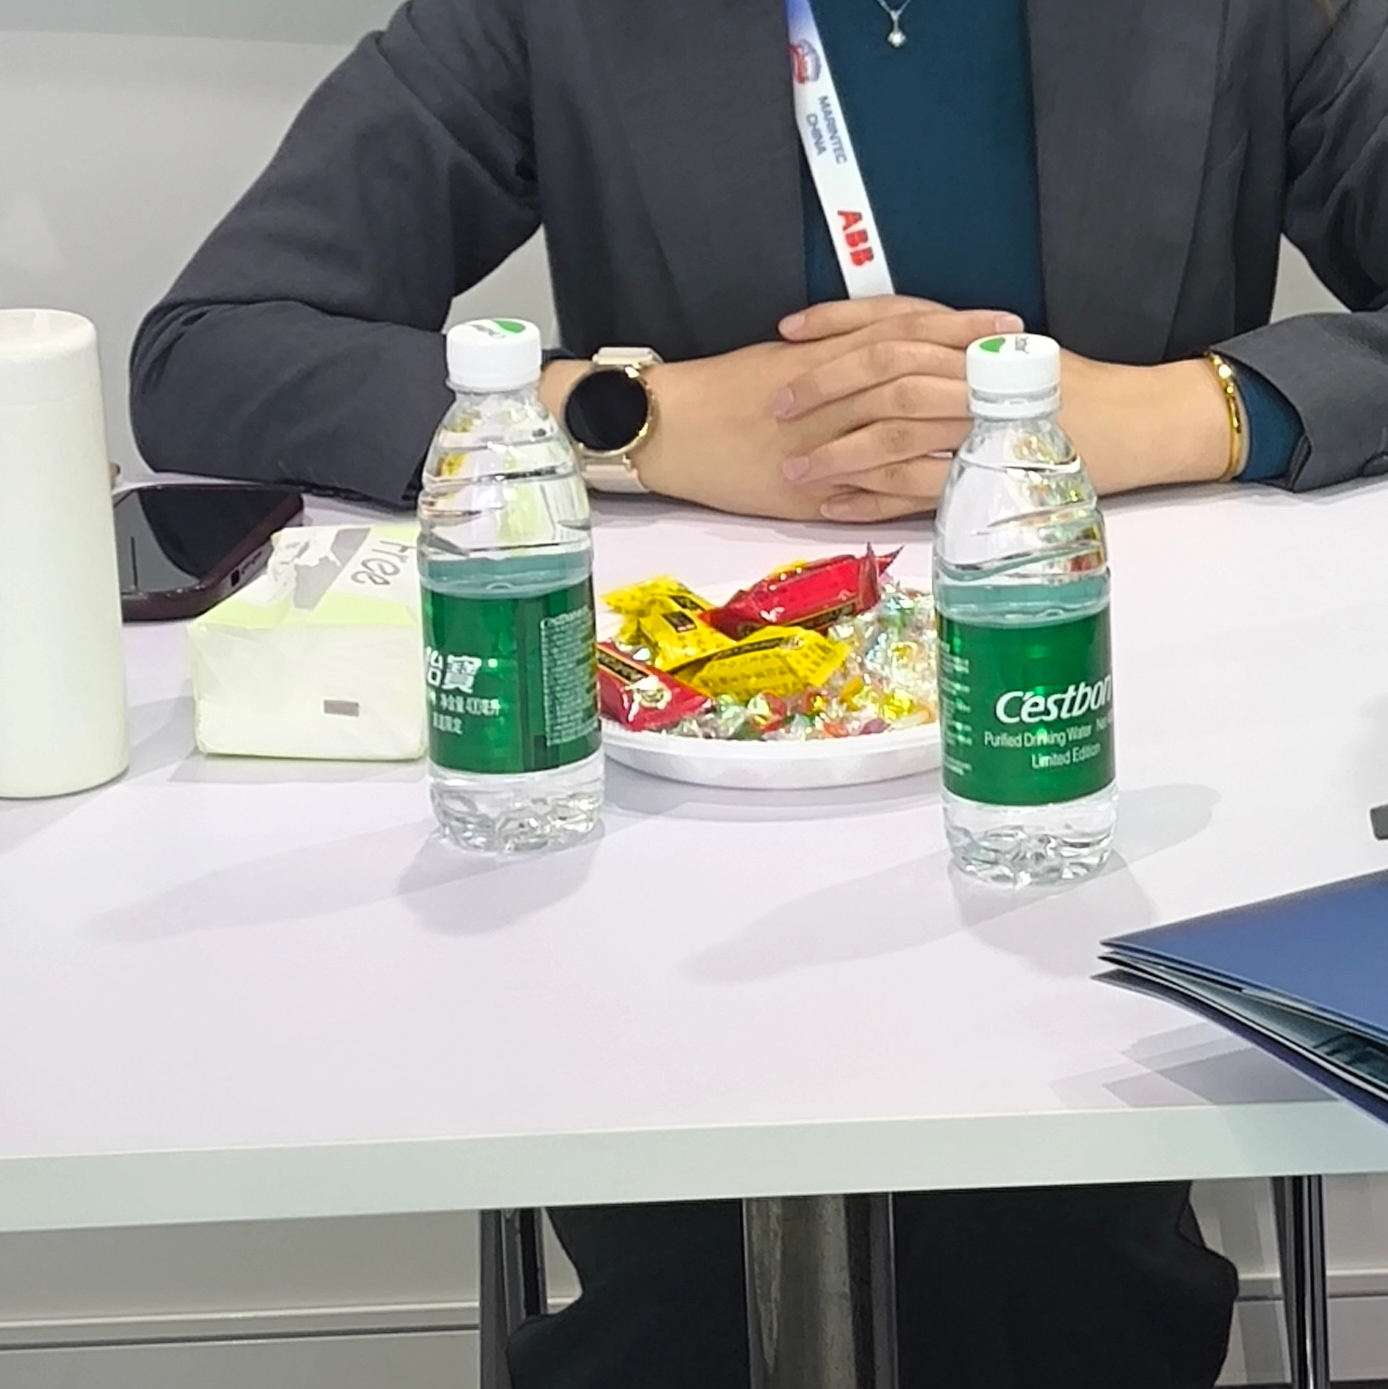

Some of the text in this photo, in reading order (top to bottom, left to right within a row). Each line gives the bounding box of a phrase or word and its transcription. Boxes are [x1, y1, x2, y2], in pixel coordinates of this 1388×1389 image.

[805, 112, 827, 157] CHINA
[817, 95, 848, 165] MARINTEC
[837, 208, 875, 268] ABB
[984, 730, 1022, 748] Purified
[1023, 729, 1067, 748] Drinking
[1066, 724, 1093, 741] Water
[1031, 742, 1101, 770] Limited Edition
